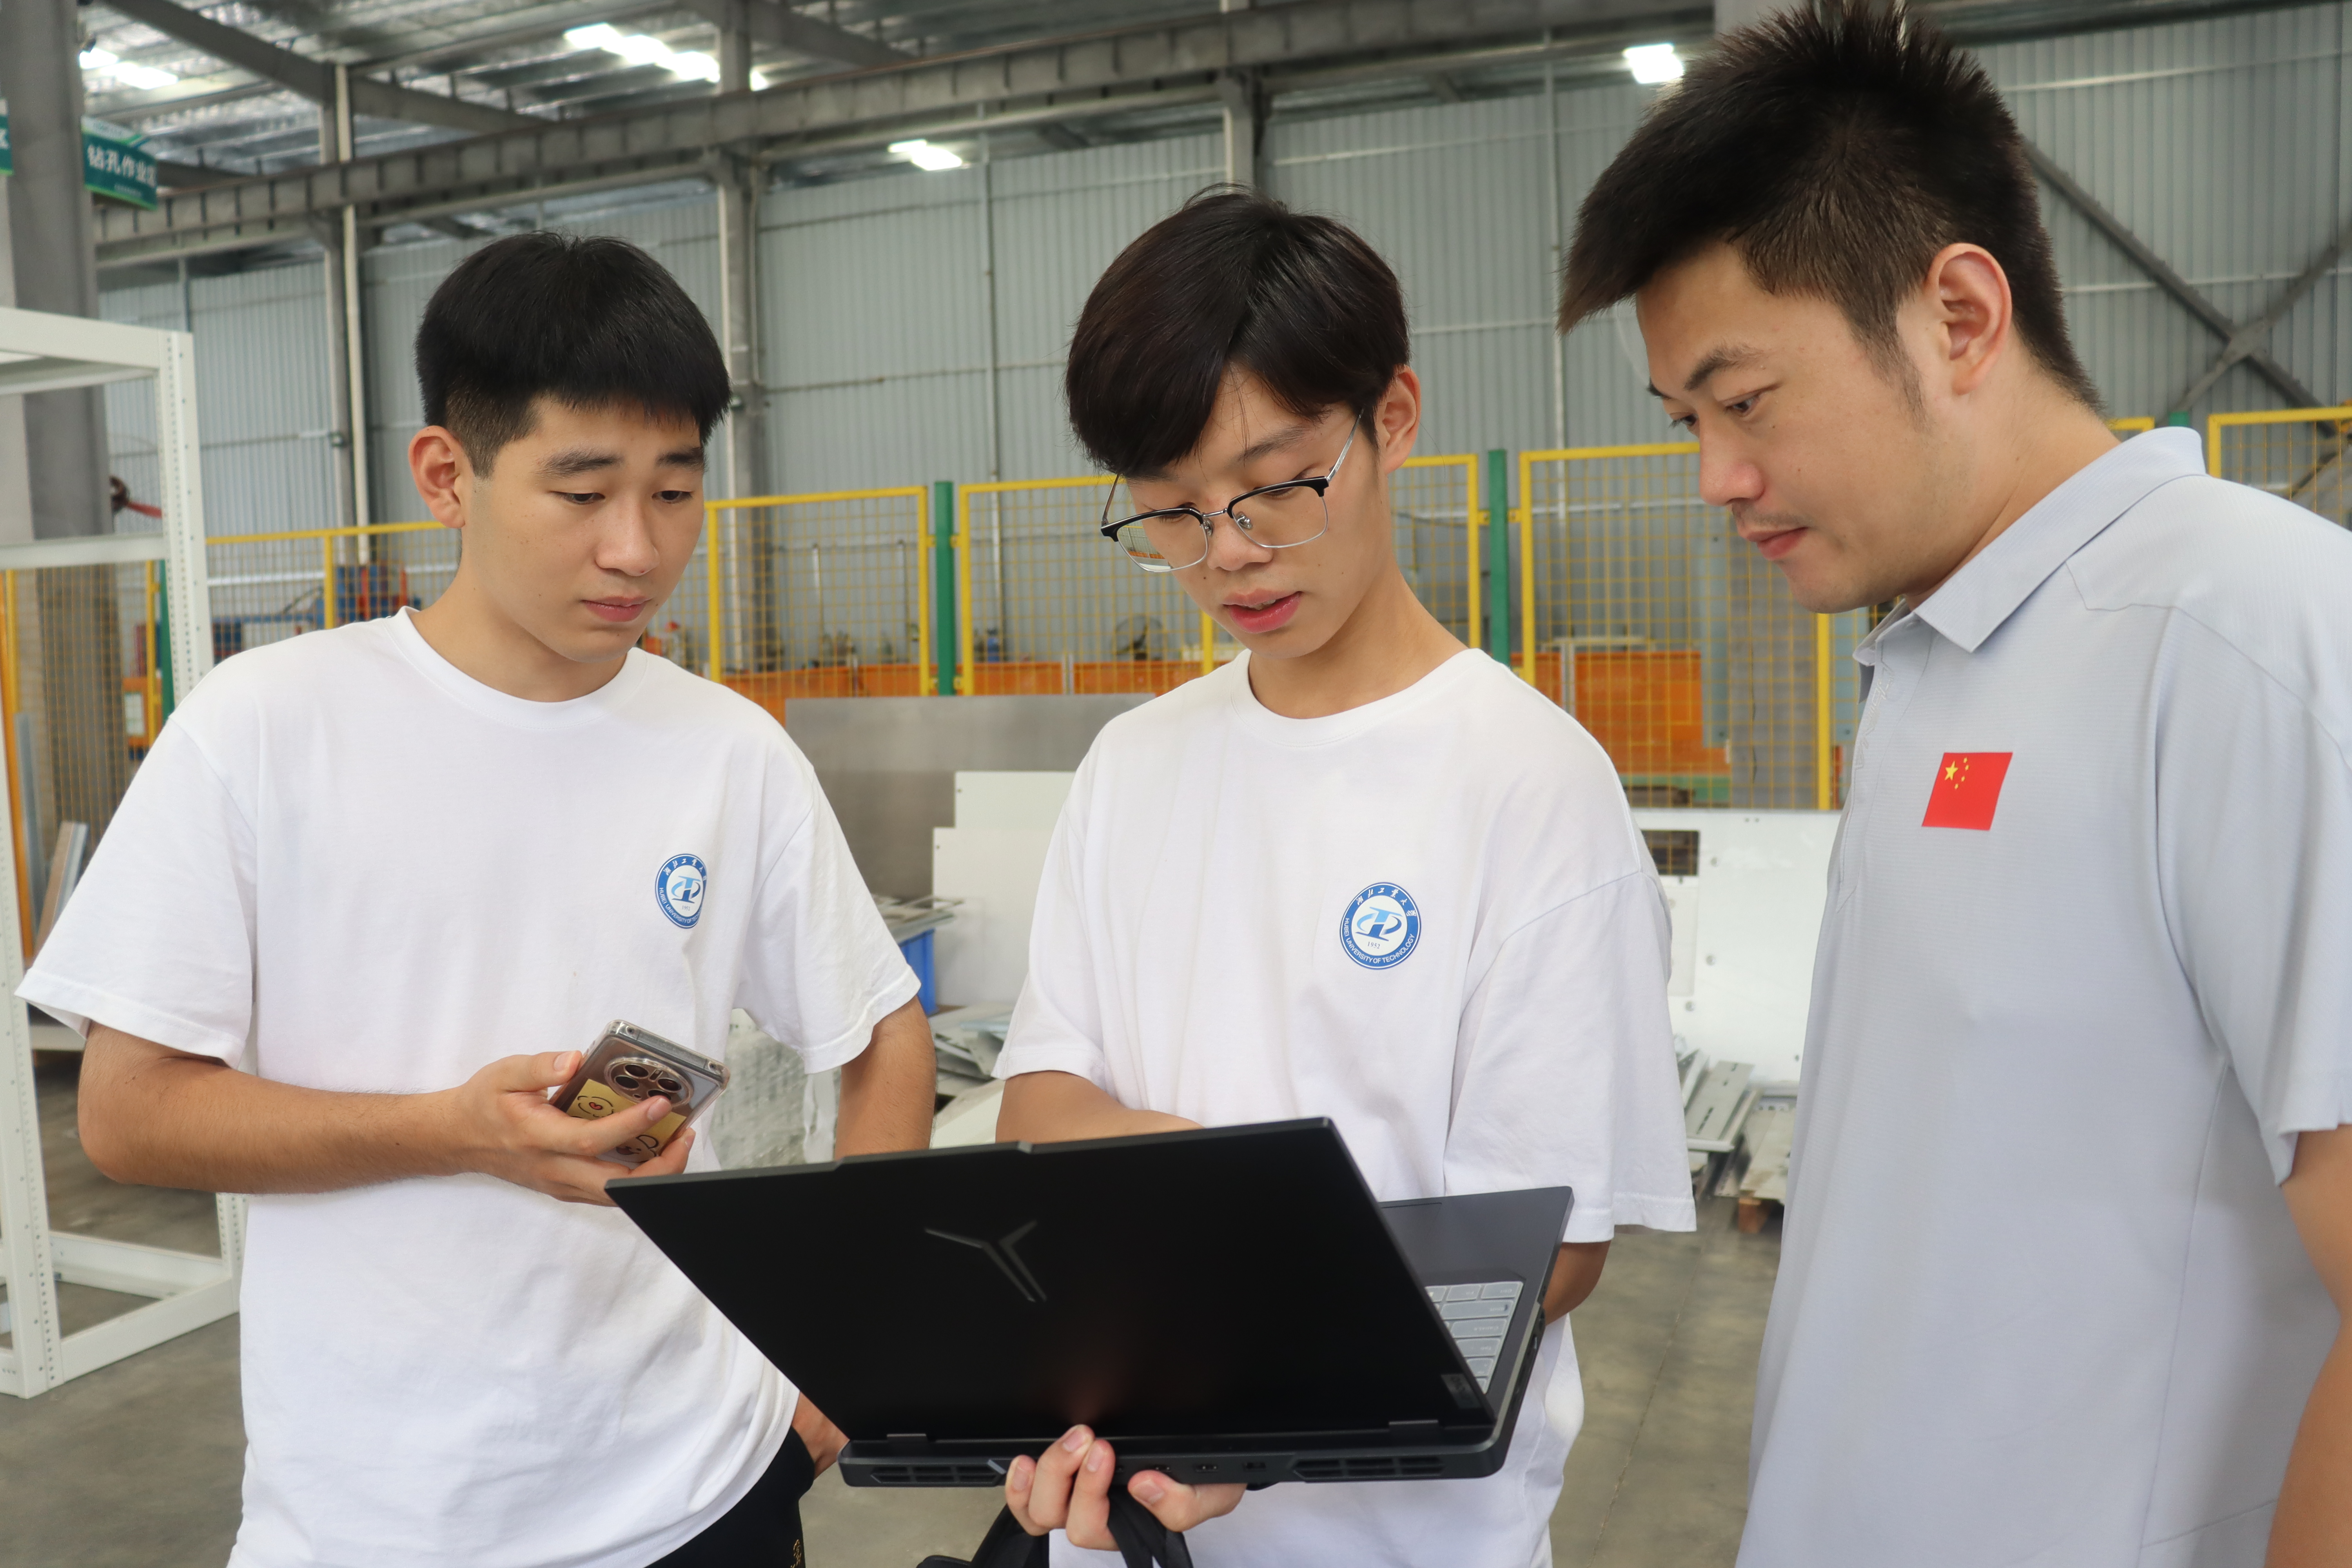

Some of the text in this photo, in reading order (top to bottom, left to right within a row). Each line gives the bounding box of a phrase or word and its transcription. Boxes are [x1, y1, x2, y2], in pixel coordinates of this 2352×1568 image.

[659, 887, 667, 904] HUBEI
[665, 904, 688, 924] UNIVERSITY
[1346, 937, 1373, 963] UNIVERSITY
[1381, 934, 1415, 963] TECHNOLOGY
